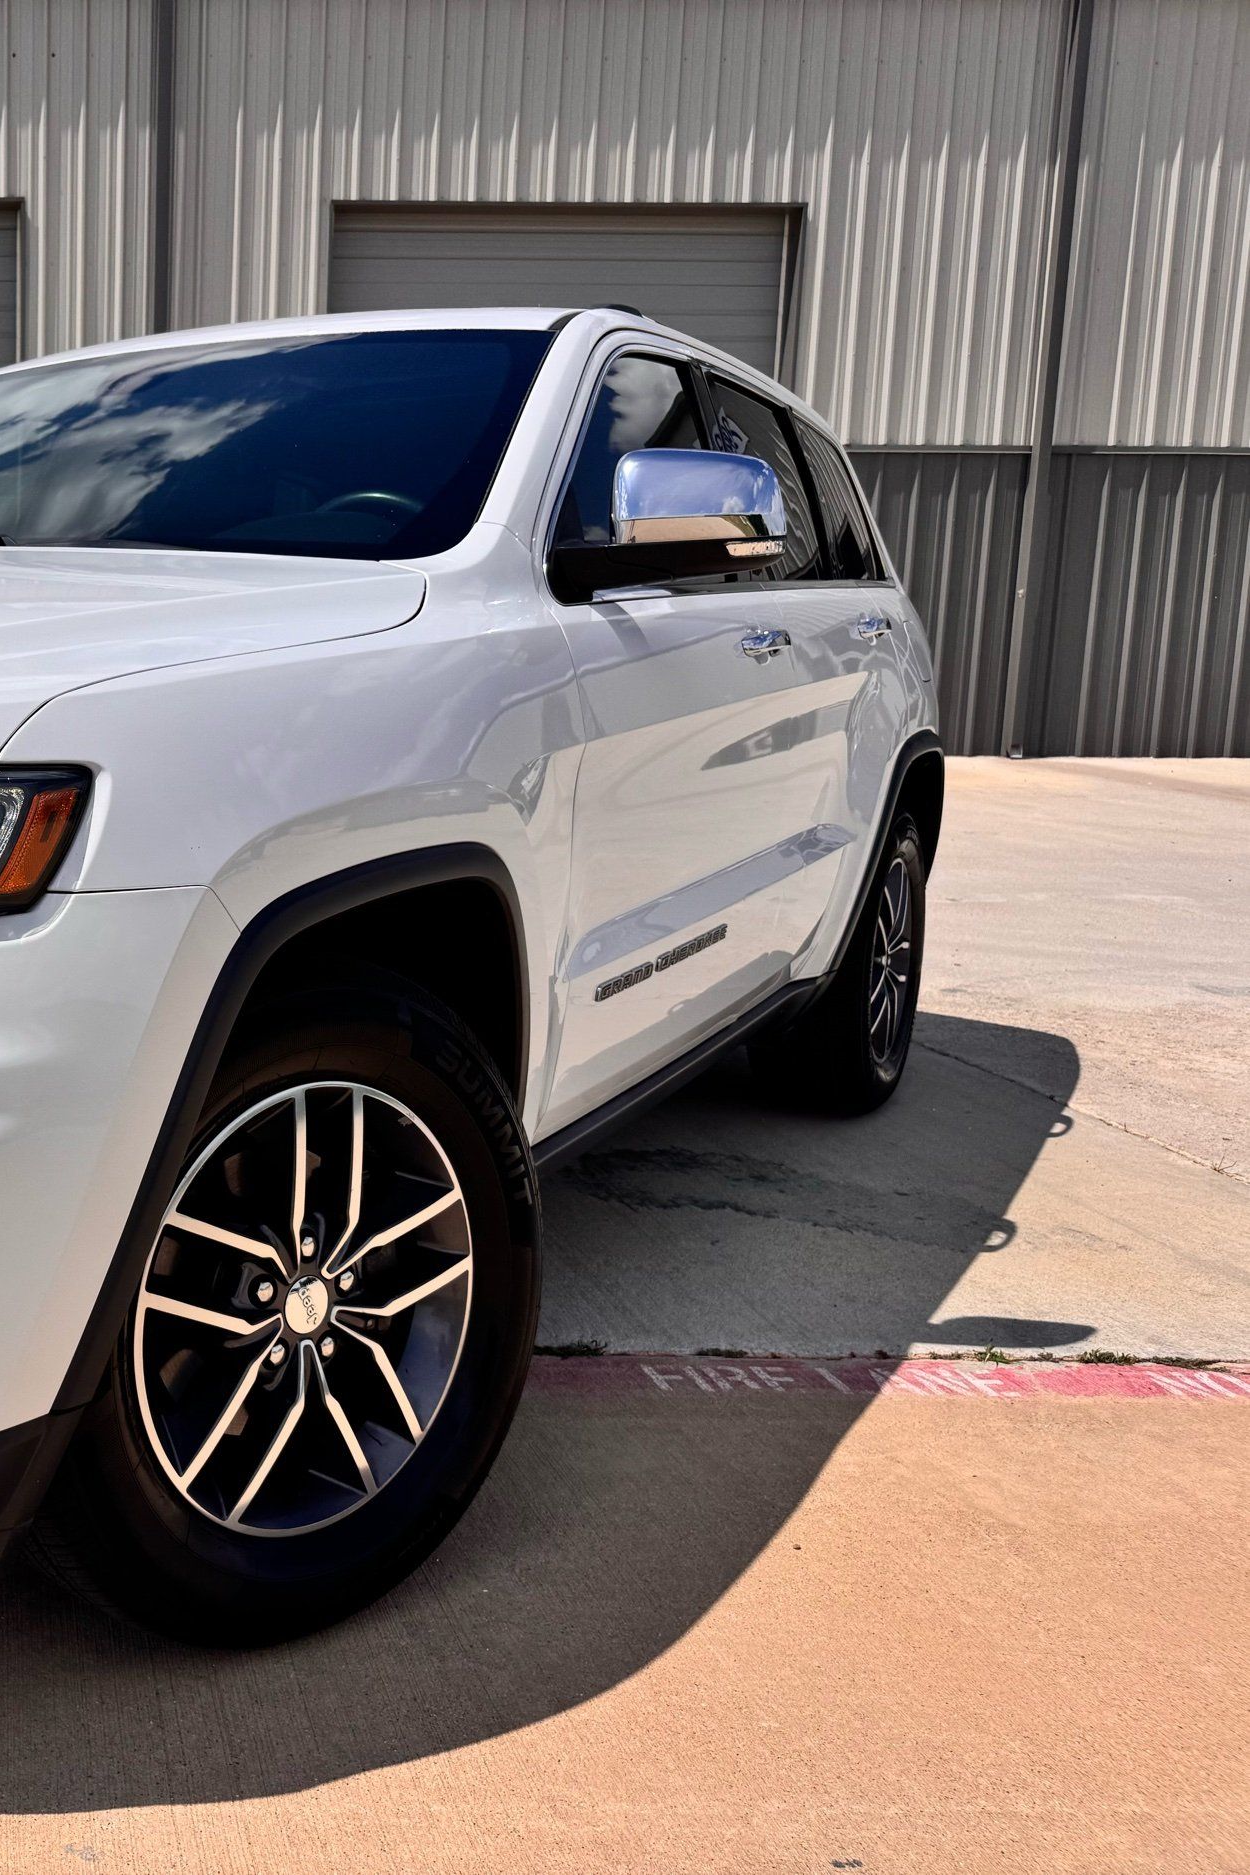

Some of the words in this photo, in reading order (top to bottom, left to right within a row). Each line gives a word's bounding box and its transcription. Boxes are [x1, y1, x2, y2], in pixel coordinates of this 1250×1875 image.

[594, 961, 654, 1002] GRAND
[655, 923, 728, 972] CHEROKEE
[639, 1365, 794, 1393] FIRE
[814, 1367, 1021, 1398] LANE
